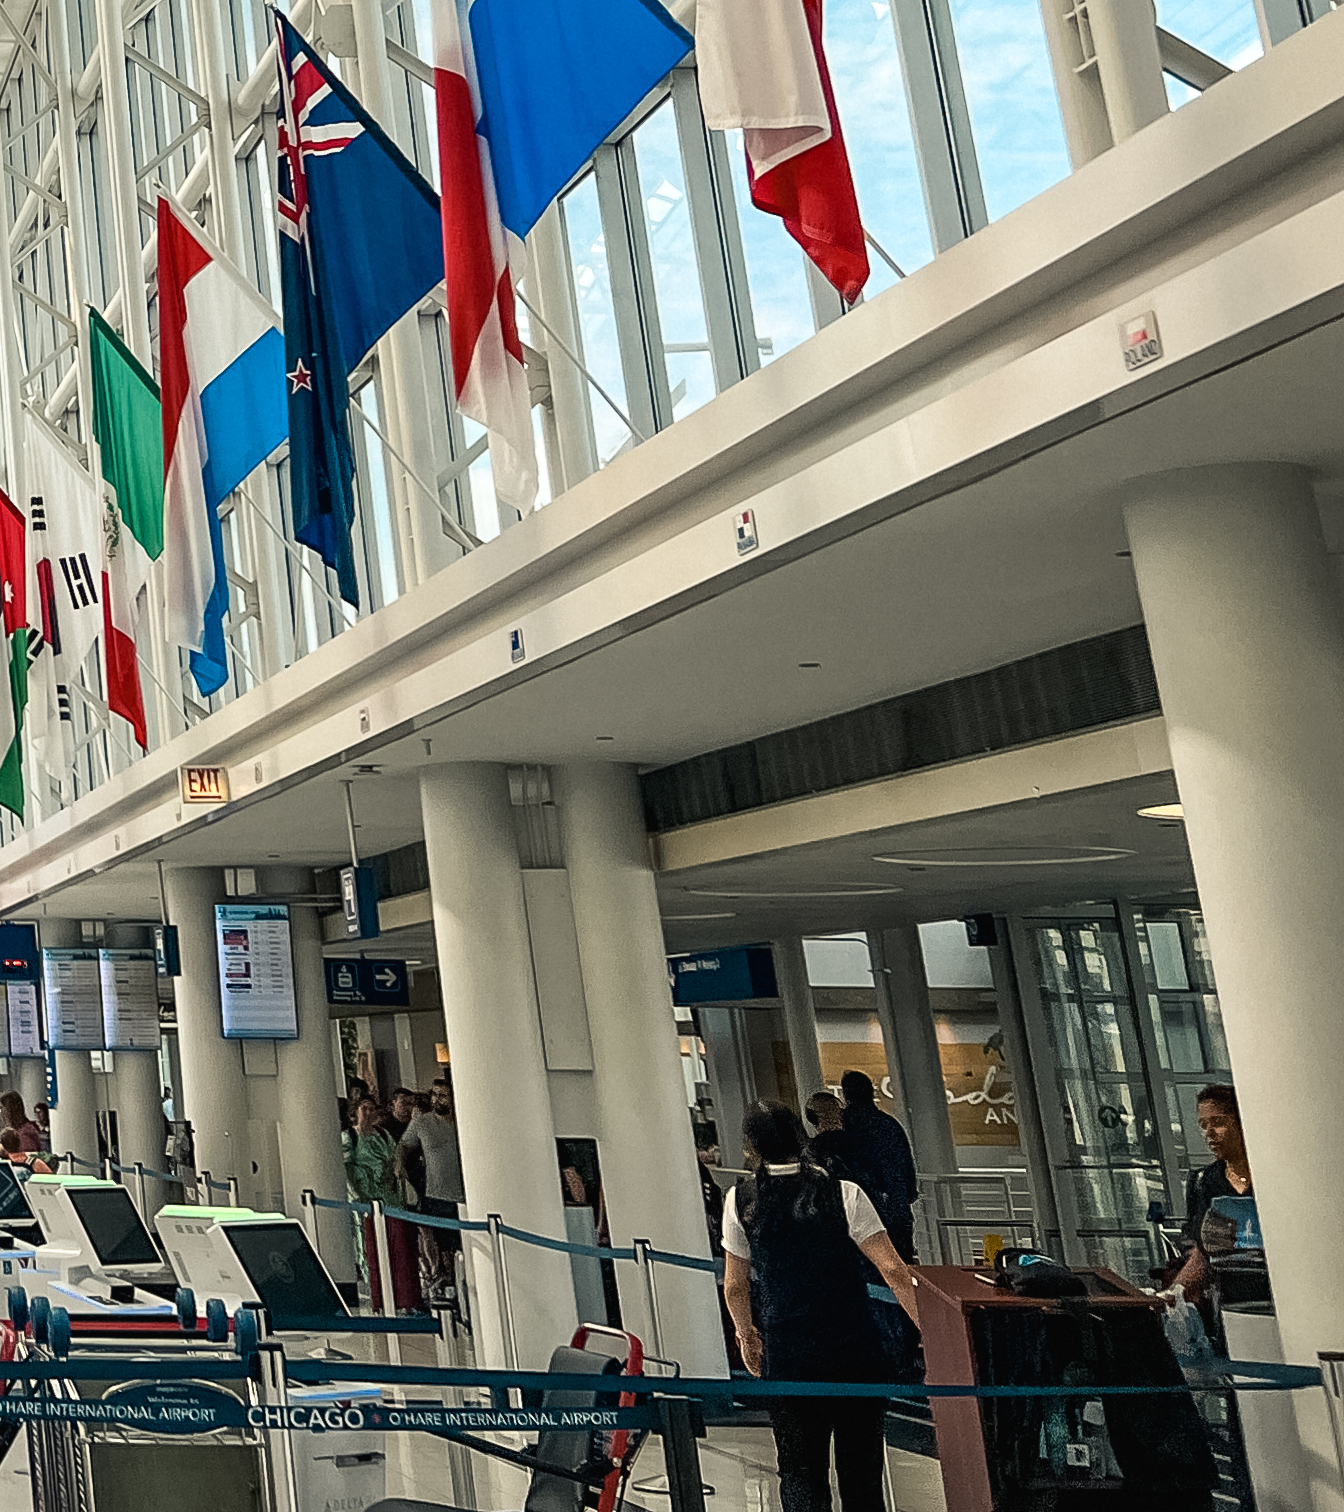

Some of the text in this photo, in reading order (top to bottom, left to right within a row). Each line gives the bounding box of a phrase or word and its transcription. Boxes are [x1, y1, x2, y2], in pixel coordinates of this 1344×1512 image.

[187, 768, 220, 793] EXIT
[984, 1107, 1018, 1125] AN
[45, 1400, 157, 1420] INTERNATIONAL
[159, 1405, 217, 1422] AIRPORT
[247, 1404, 365, 1429] CHICAGO
[388, 1411, 442, 1427] O'HARE
[445, 1411, 558, 1428] INTERNATIONAL
[561, 1410, 619, 1427] AIRPORT
